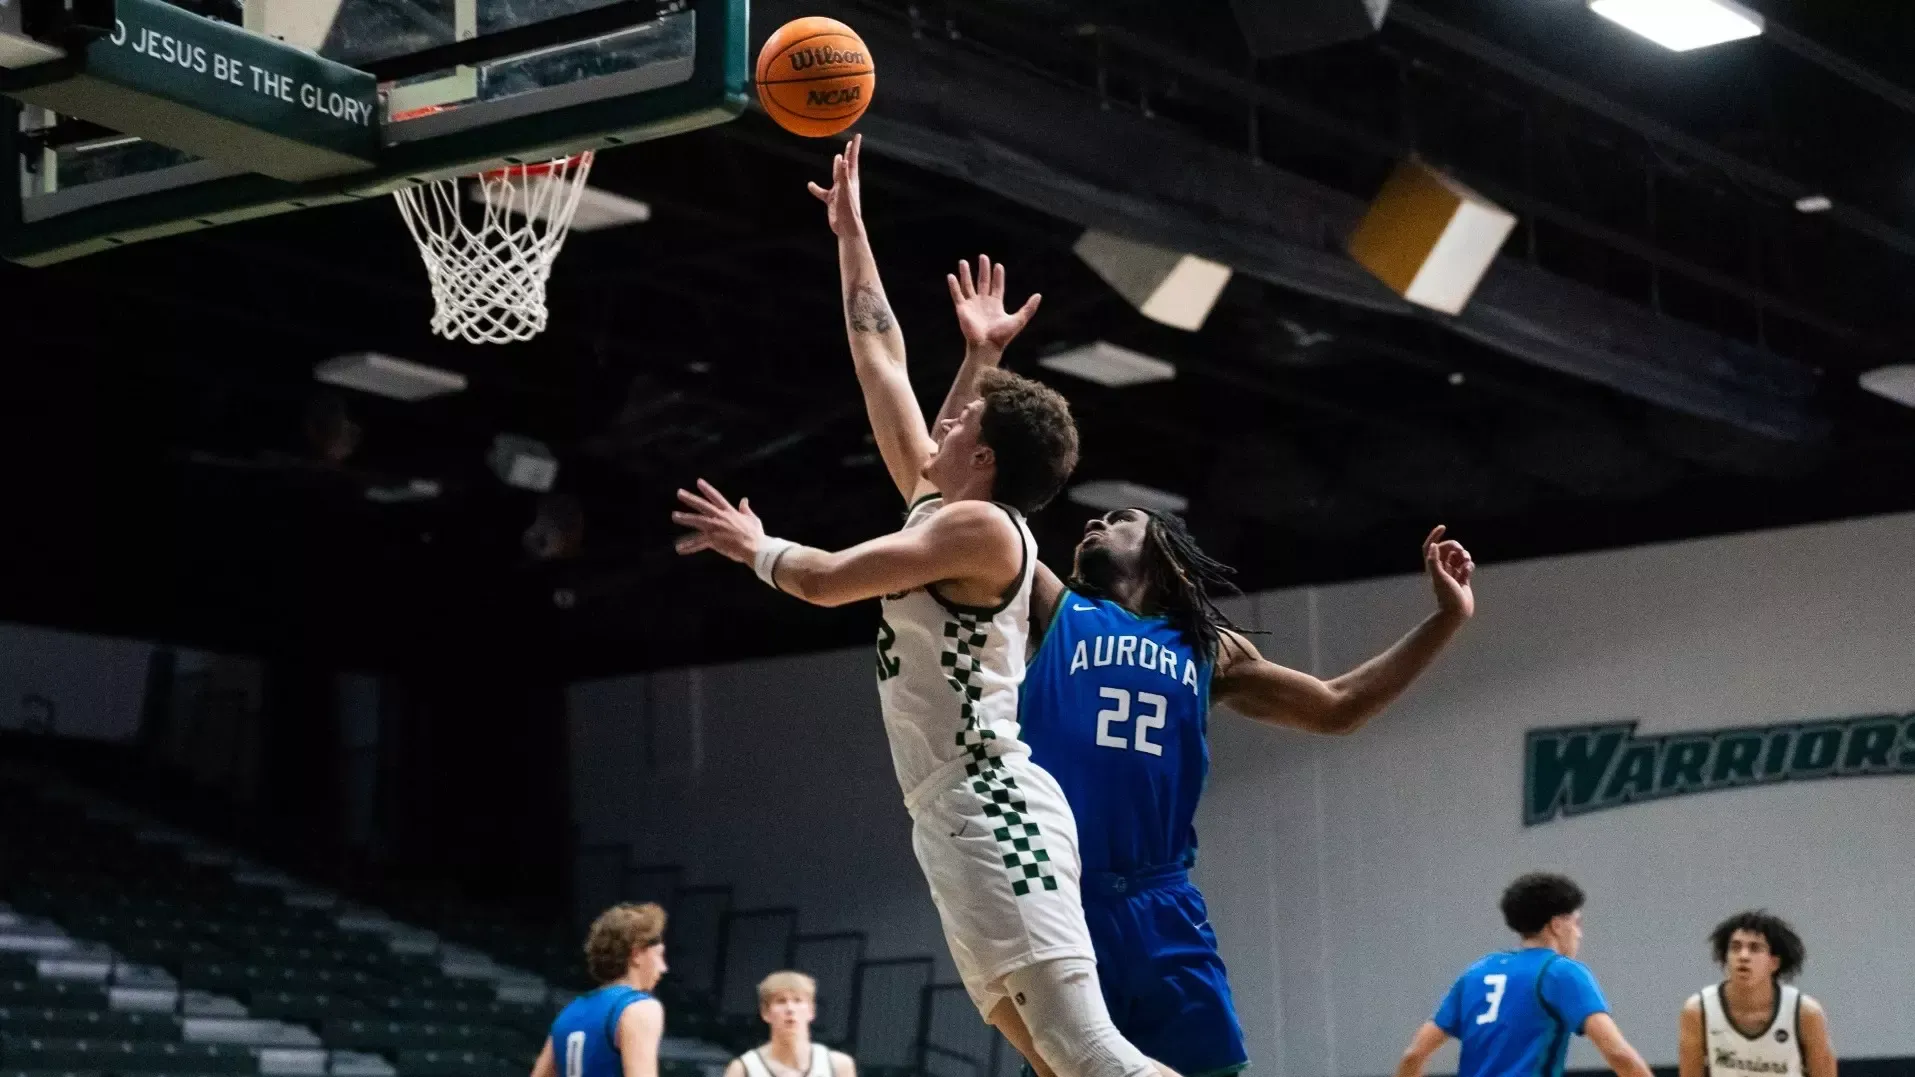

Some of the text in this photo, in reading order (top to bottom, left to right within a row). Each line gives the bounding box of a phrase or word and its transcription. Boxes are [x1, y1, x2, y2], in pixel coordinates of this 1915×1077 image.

[132, 28, 207, 73] JESUS
[213, 53, 244, 87] BE
[249, 65, 295, 104] THE
[300, 83, 373, 127] GLORY
[788, 45, 865, 71] Wilson
[806, 85, 860, 106] NCAA
[876, 619, 900, 681] 2
[1069, 635, 1199, 697] AURORA
[1096, 686, 1168, 757] 22
[1476, 973, 1507, 1025] 3
